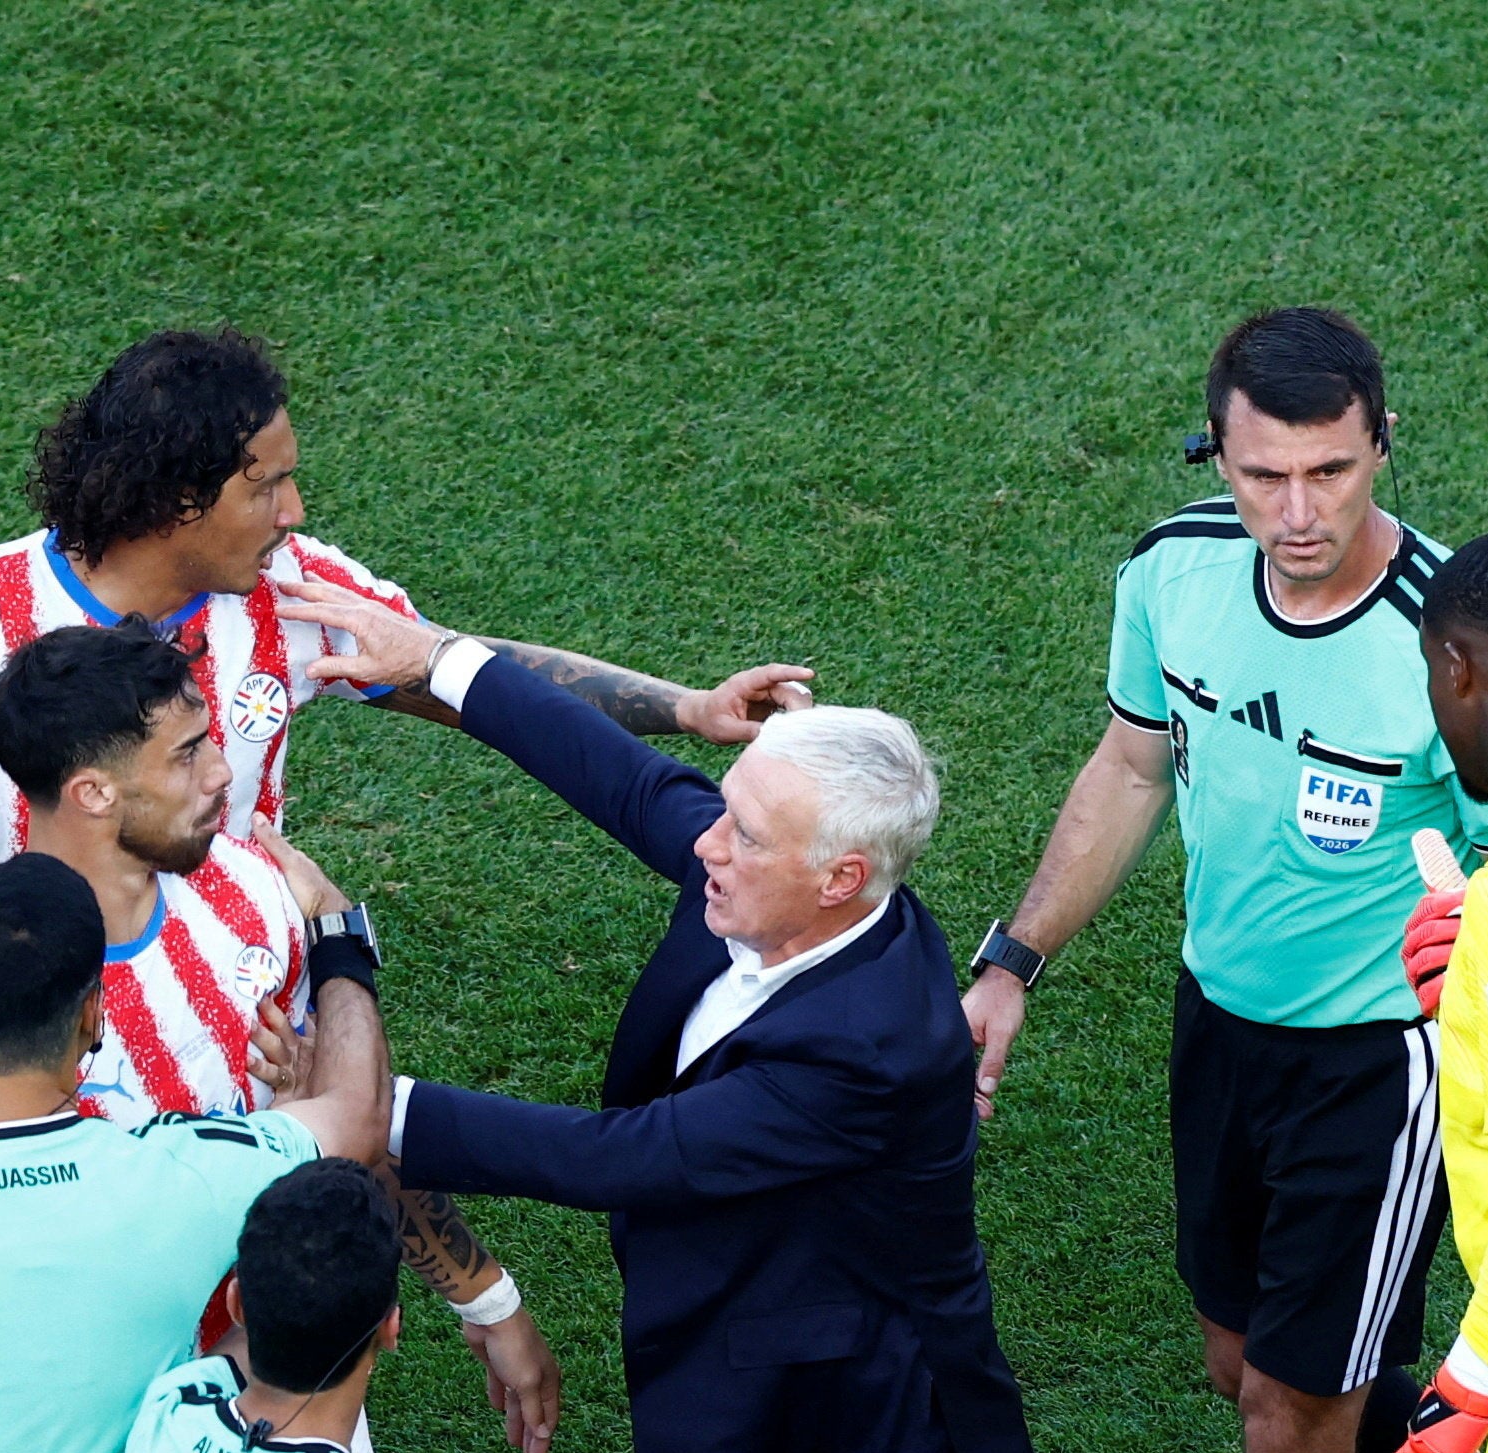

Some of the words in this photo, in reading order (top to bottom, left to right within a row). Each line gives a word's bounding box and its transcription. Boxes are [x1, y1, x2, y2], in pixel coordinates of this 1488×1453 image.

[246, 677, 265, 691] APF
[1307, 775, 1373, 807] FIFA
[1303, 809, 1371, 827] REFEREE
[1318, 839, 1350, 850] 2026
